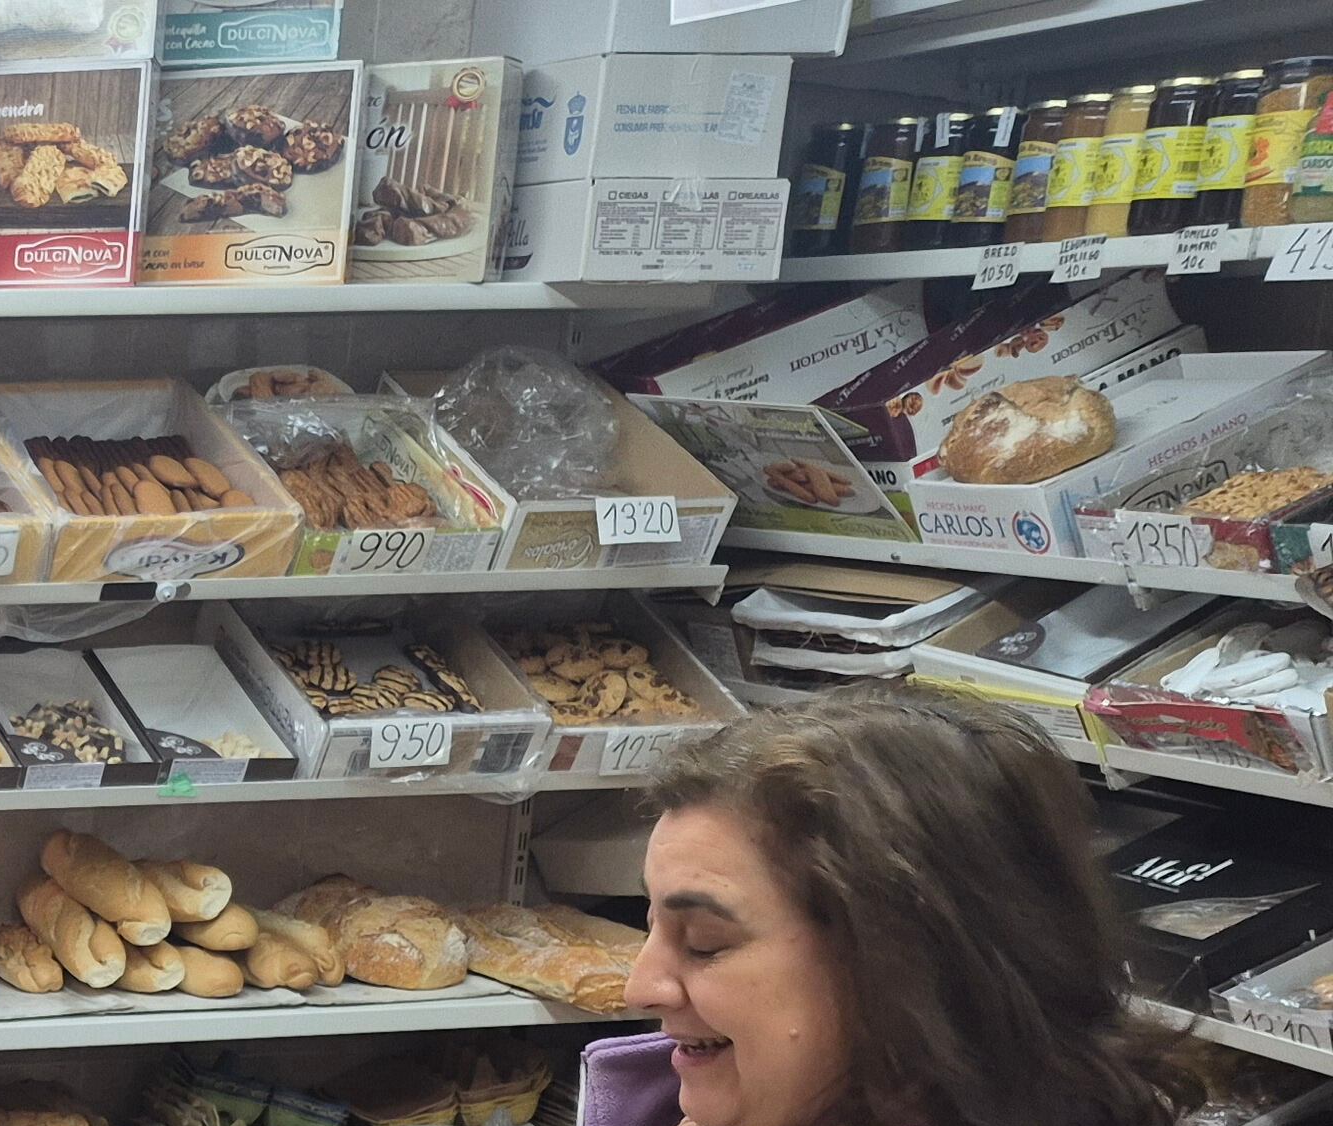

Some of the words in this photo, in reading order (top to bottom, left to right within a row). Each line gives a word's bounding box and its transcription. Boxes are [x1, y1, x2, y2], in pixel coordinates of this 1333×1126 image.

[984, 245, 1018, 259] BREZO
[1148, 434, 1198, 468] HECHOS
[1210, 412, 1248, 437] MANO
[603, 501, 674, 536] 13'20
[918, 513, 993, 536] CARLOS
[351, 531, 426, 571] 9'90
[1126, 521, 1199, 568] 13'50
[378, 722, 445, 761] 9'50
